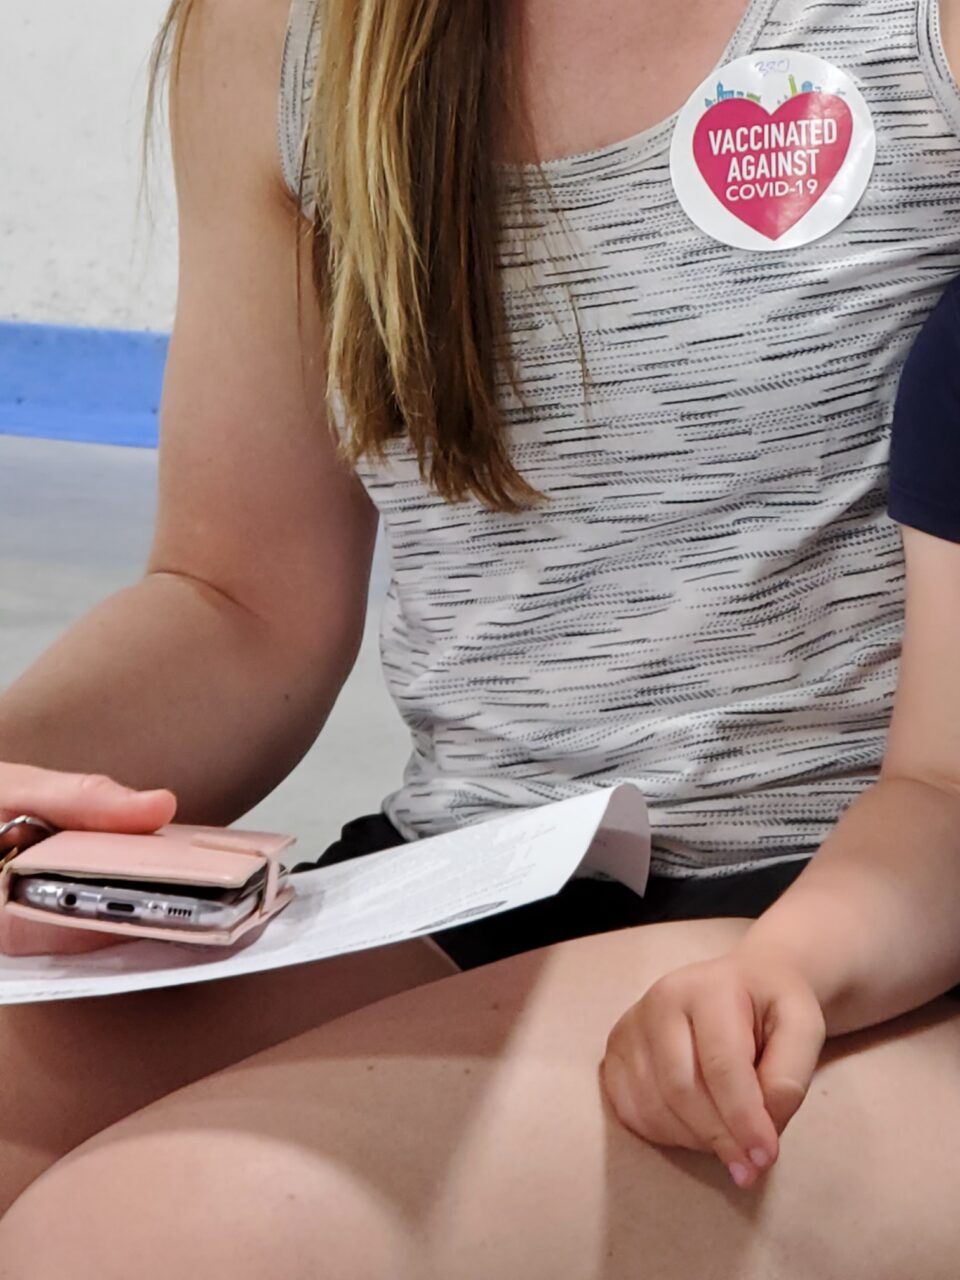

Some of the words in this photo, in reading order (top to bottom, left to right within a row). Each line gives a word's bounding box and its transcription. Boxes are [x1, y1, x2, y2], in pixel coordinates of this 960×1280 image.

[708, 118, 838, 156] VACCINATED
[727, 149, 820, 183] AGAINST
[725, 179, 819, 201] COVID-19
